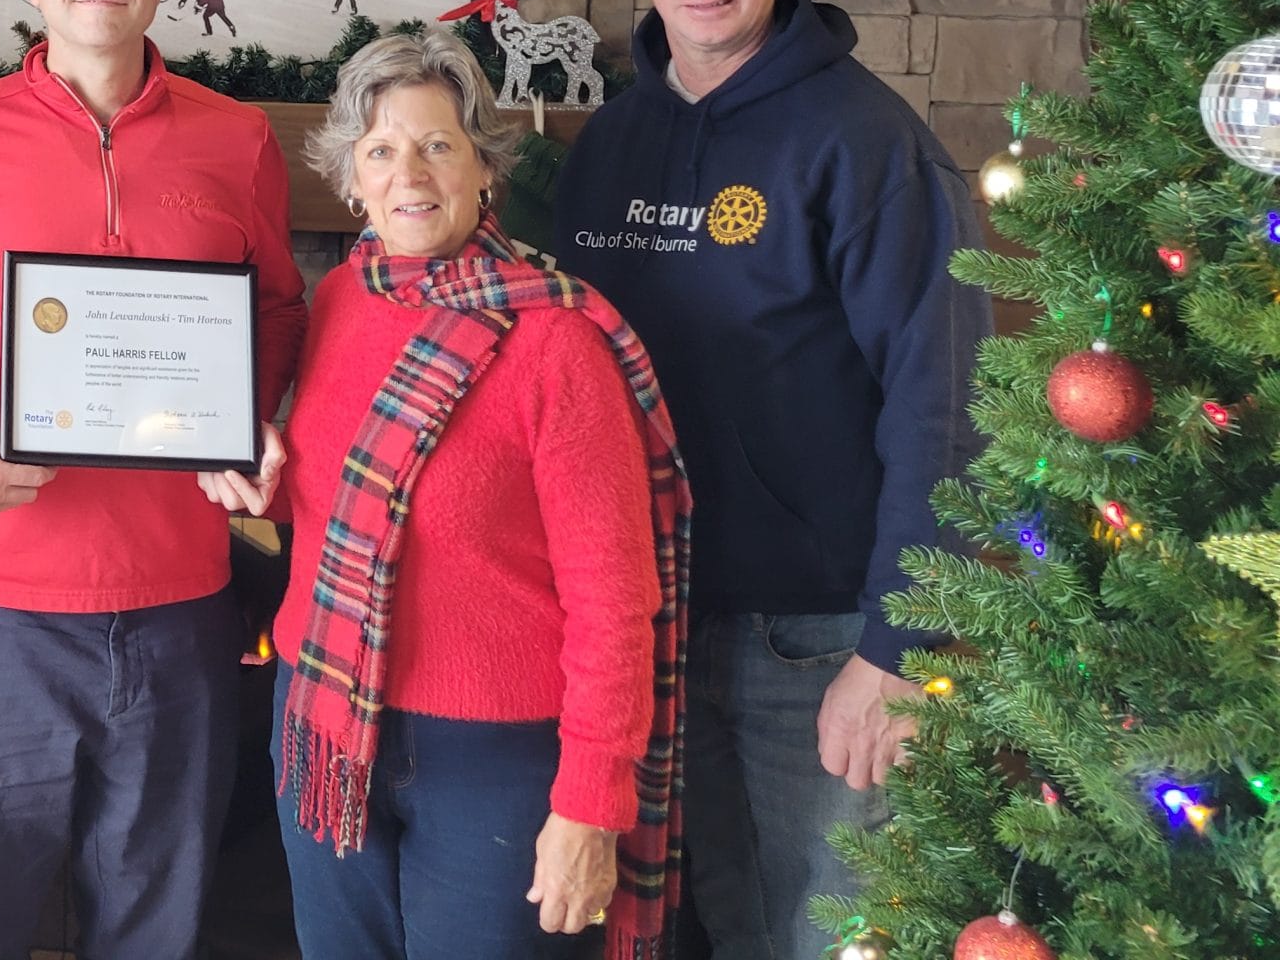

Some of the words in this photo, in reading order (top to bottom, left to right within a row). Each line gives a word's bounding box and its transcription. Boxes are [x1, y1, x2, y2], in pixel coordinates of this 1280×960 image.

[626, 199, 706, 232] Rotary
[575, 231, 611, 248] Club
[608, 231, 623, 249] of
[85, 310, 108, 320] John
[110, 311, 170, 323] Lewandowski
[177, 314, 195, 324] Tim
[197, 315, 233, 325] Hortons
[85, 347, 111, 357] PAUL
[112, 348, 147, 359] HARRIS
[149, 350, 187, 361] FELLOW
[24, 413, 54, 425] Rotary
